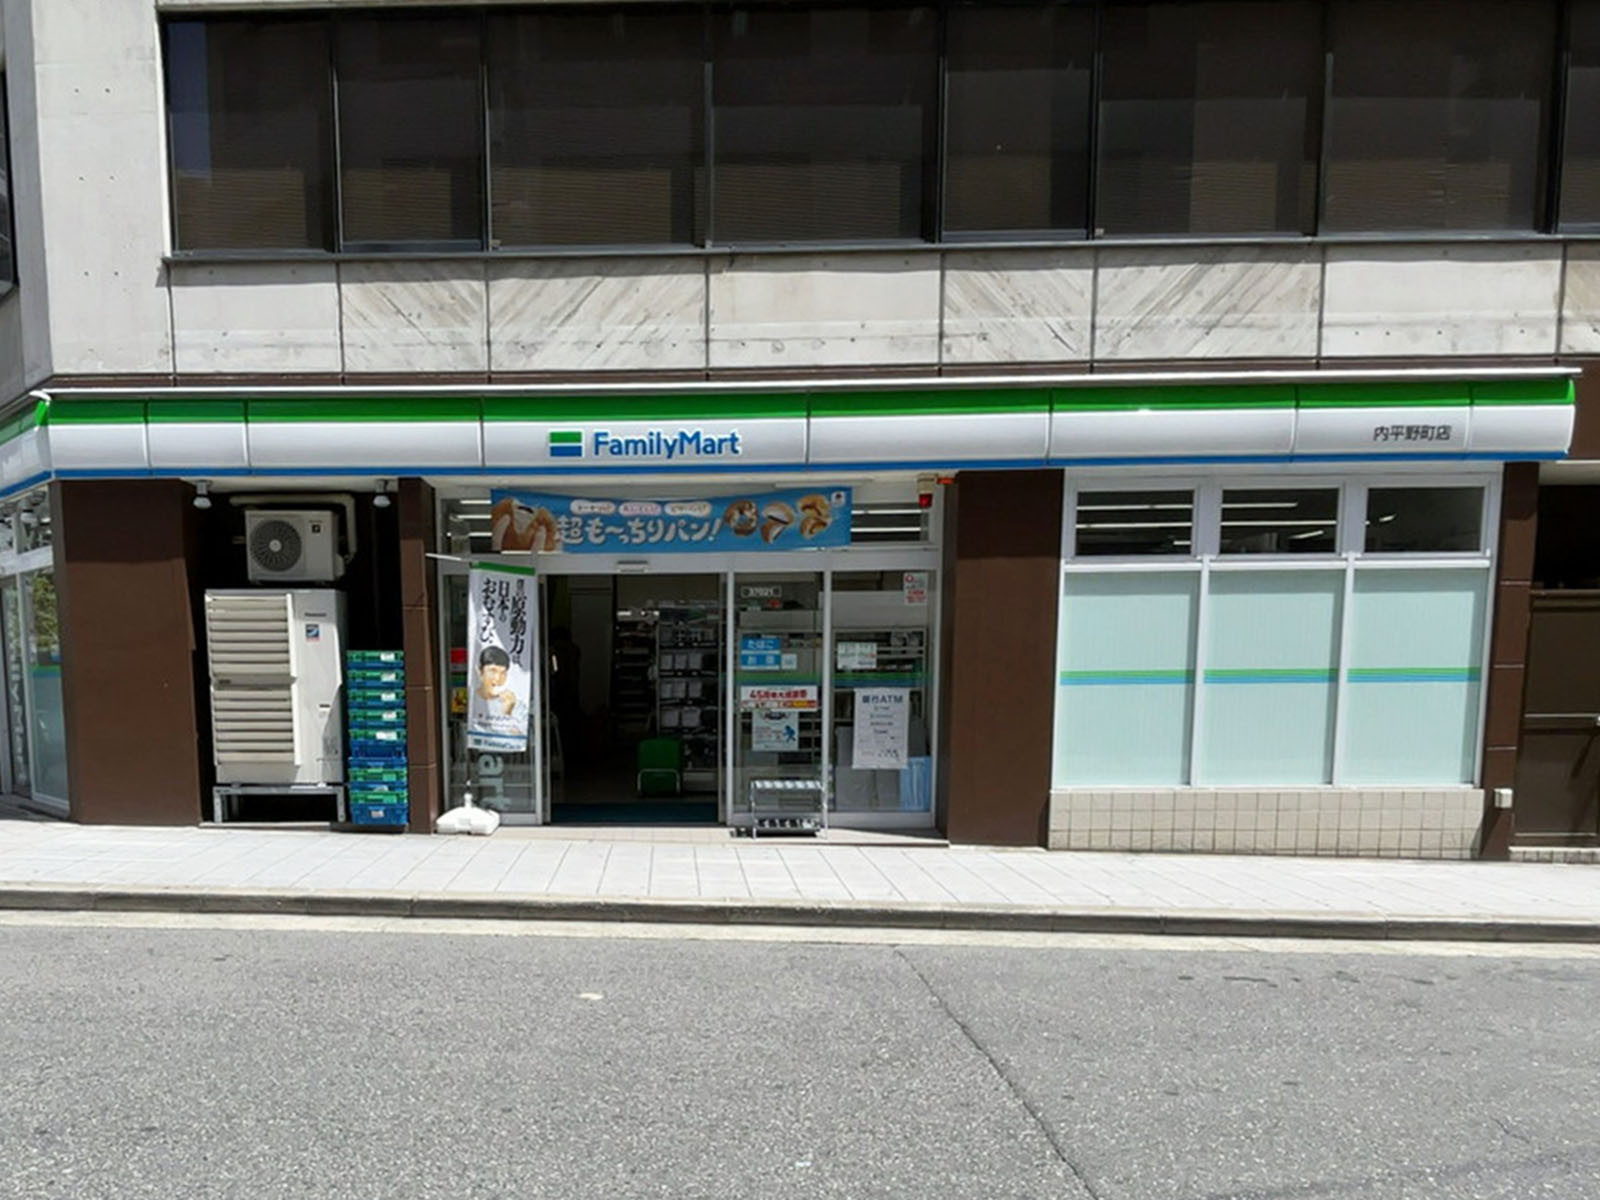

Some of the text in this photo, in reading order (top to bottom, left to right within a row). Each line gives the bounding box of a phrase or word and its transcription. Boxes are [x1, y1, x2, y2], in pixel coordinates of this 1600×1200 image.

[1373, 424, 1452, 441] 内平野町店
[593, 431, 741, 460] FamilyMart
